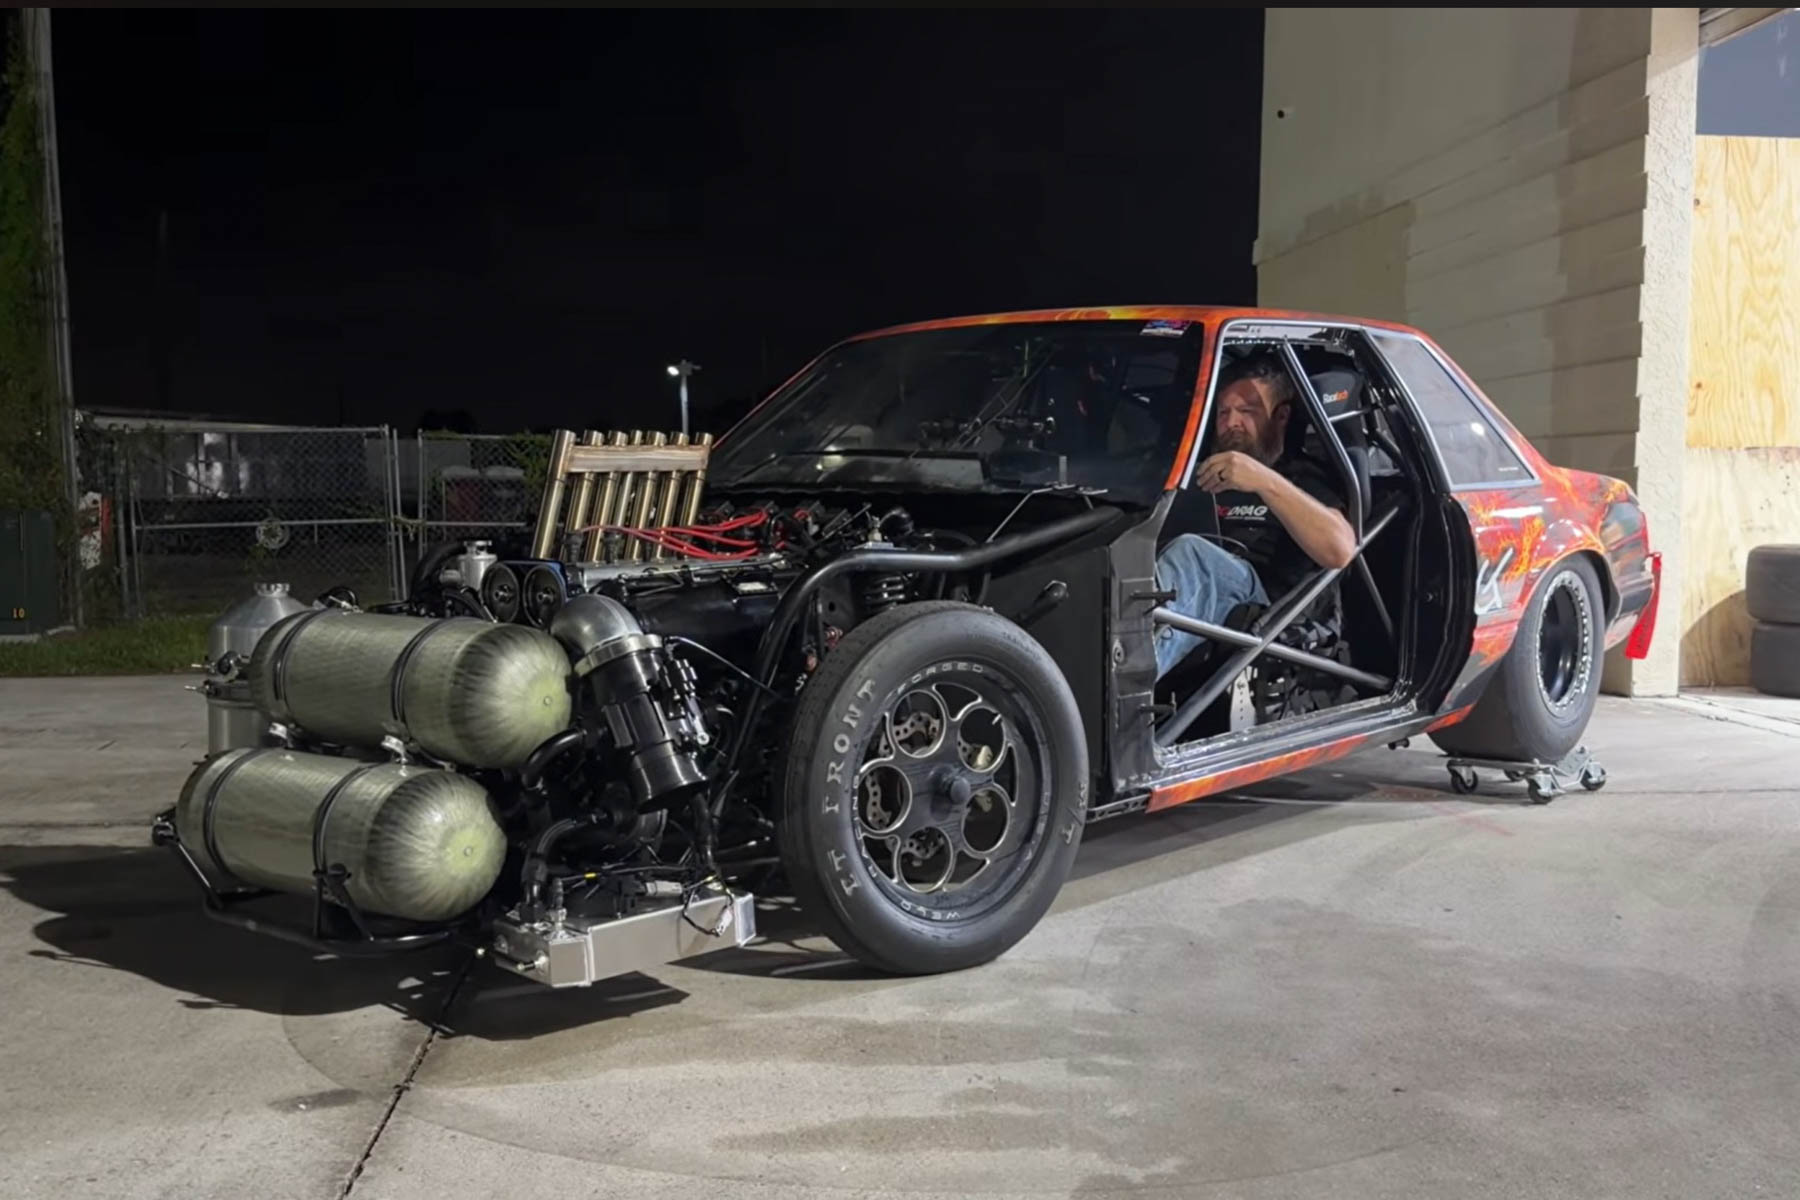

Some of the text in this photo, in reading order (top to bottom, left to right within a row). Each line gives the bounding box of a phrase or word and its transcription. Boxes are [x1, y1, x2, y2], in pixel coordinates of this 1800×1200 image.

[896, 662, 984, 694] FORGED
[822, 677, 876, 814] FRONT
[899, 899, 961, 920] WELD
